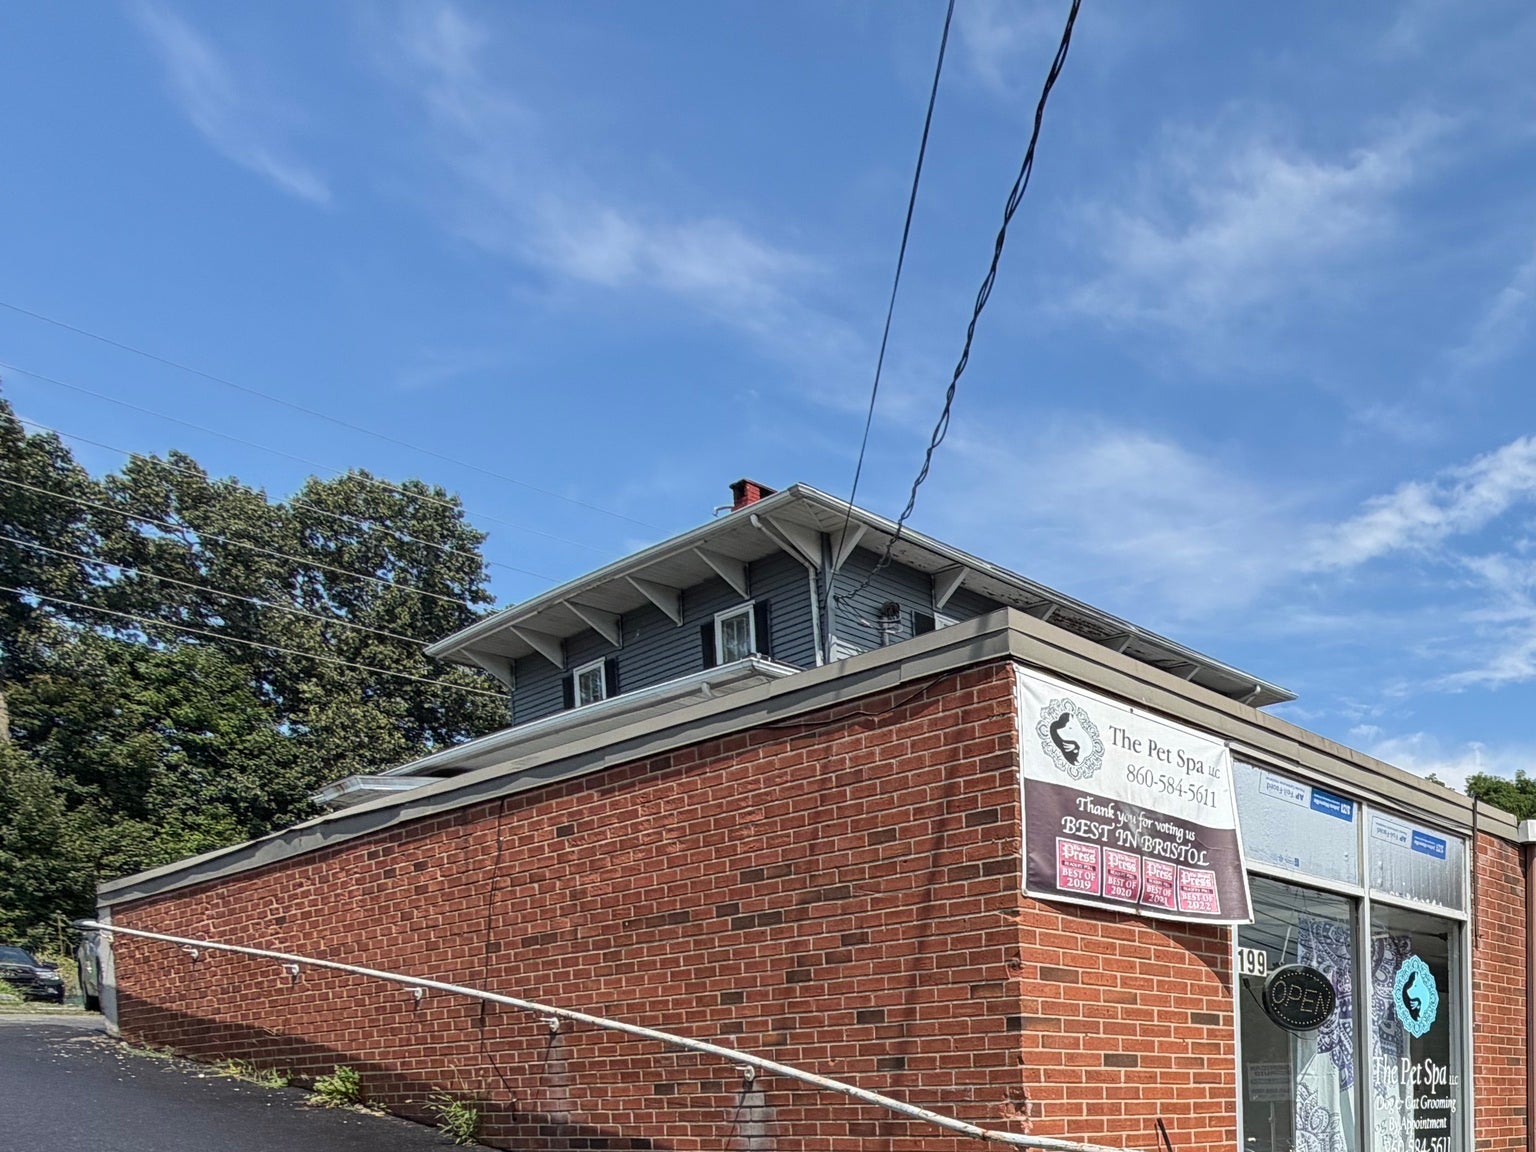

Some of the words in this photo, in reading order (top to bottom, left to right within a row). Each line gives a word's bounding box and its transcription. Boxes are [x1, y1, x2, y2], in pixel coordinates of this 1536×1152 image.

[1108, 724, 1142, 754] The
[1147, 738, 1172, 764] Pet
[1176, 749, 1204, 776] Spa
[1208, 765, 1221, 779] LLC
[1126, 763, 1217, 809] 860-584-5611
[1075, 795, 1116, 819] Thank
[1116, 809, 1136, 827] you
[1138, 811, 1154, 832] for
[1154, 820, 1184, 843] voting
[1185, 829, 1196, 841] us
[1061, 815, 1116, 842] BEST
[1115, 829, 1139, 849] IN
[1141, 835, 1210, 867] BRISTOL
[1062, 868, 1084, 879] BEST
[1084, 871, 1096, 882] OF
[1066, 877, 1092, 890] 2019
[1107, 876, 1125, 887] BEST
[1125, 880, 1137, 890] OF
[1111, 885, 1132, 898] 2020
[1146, 884, 1162, 894] BEST
[1163, 887, 1172, 897] OF
[1182, 892, 1202, 902] BEST
[1202, 893, 1213, 903] OF
[1186, 900, 1212, 911] 2022
[1238, 948, 1265, 975] 199
[1272, 980, 1332, 1017] OPEN
[1372, 1054, 1398, 1086] The
[1401, 1057, 1423, 1086] Pet
[1424, 1057, 1447, 1095] Spa
[1449, 1074, 1460, 1086] LLC
[1405, 1095, 1420, 1110] Cat
[1420, 1094, 1457, 1113] Grooming
[1401, 1115, 1447, 1136] Appointment
